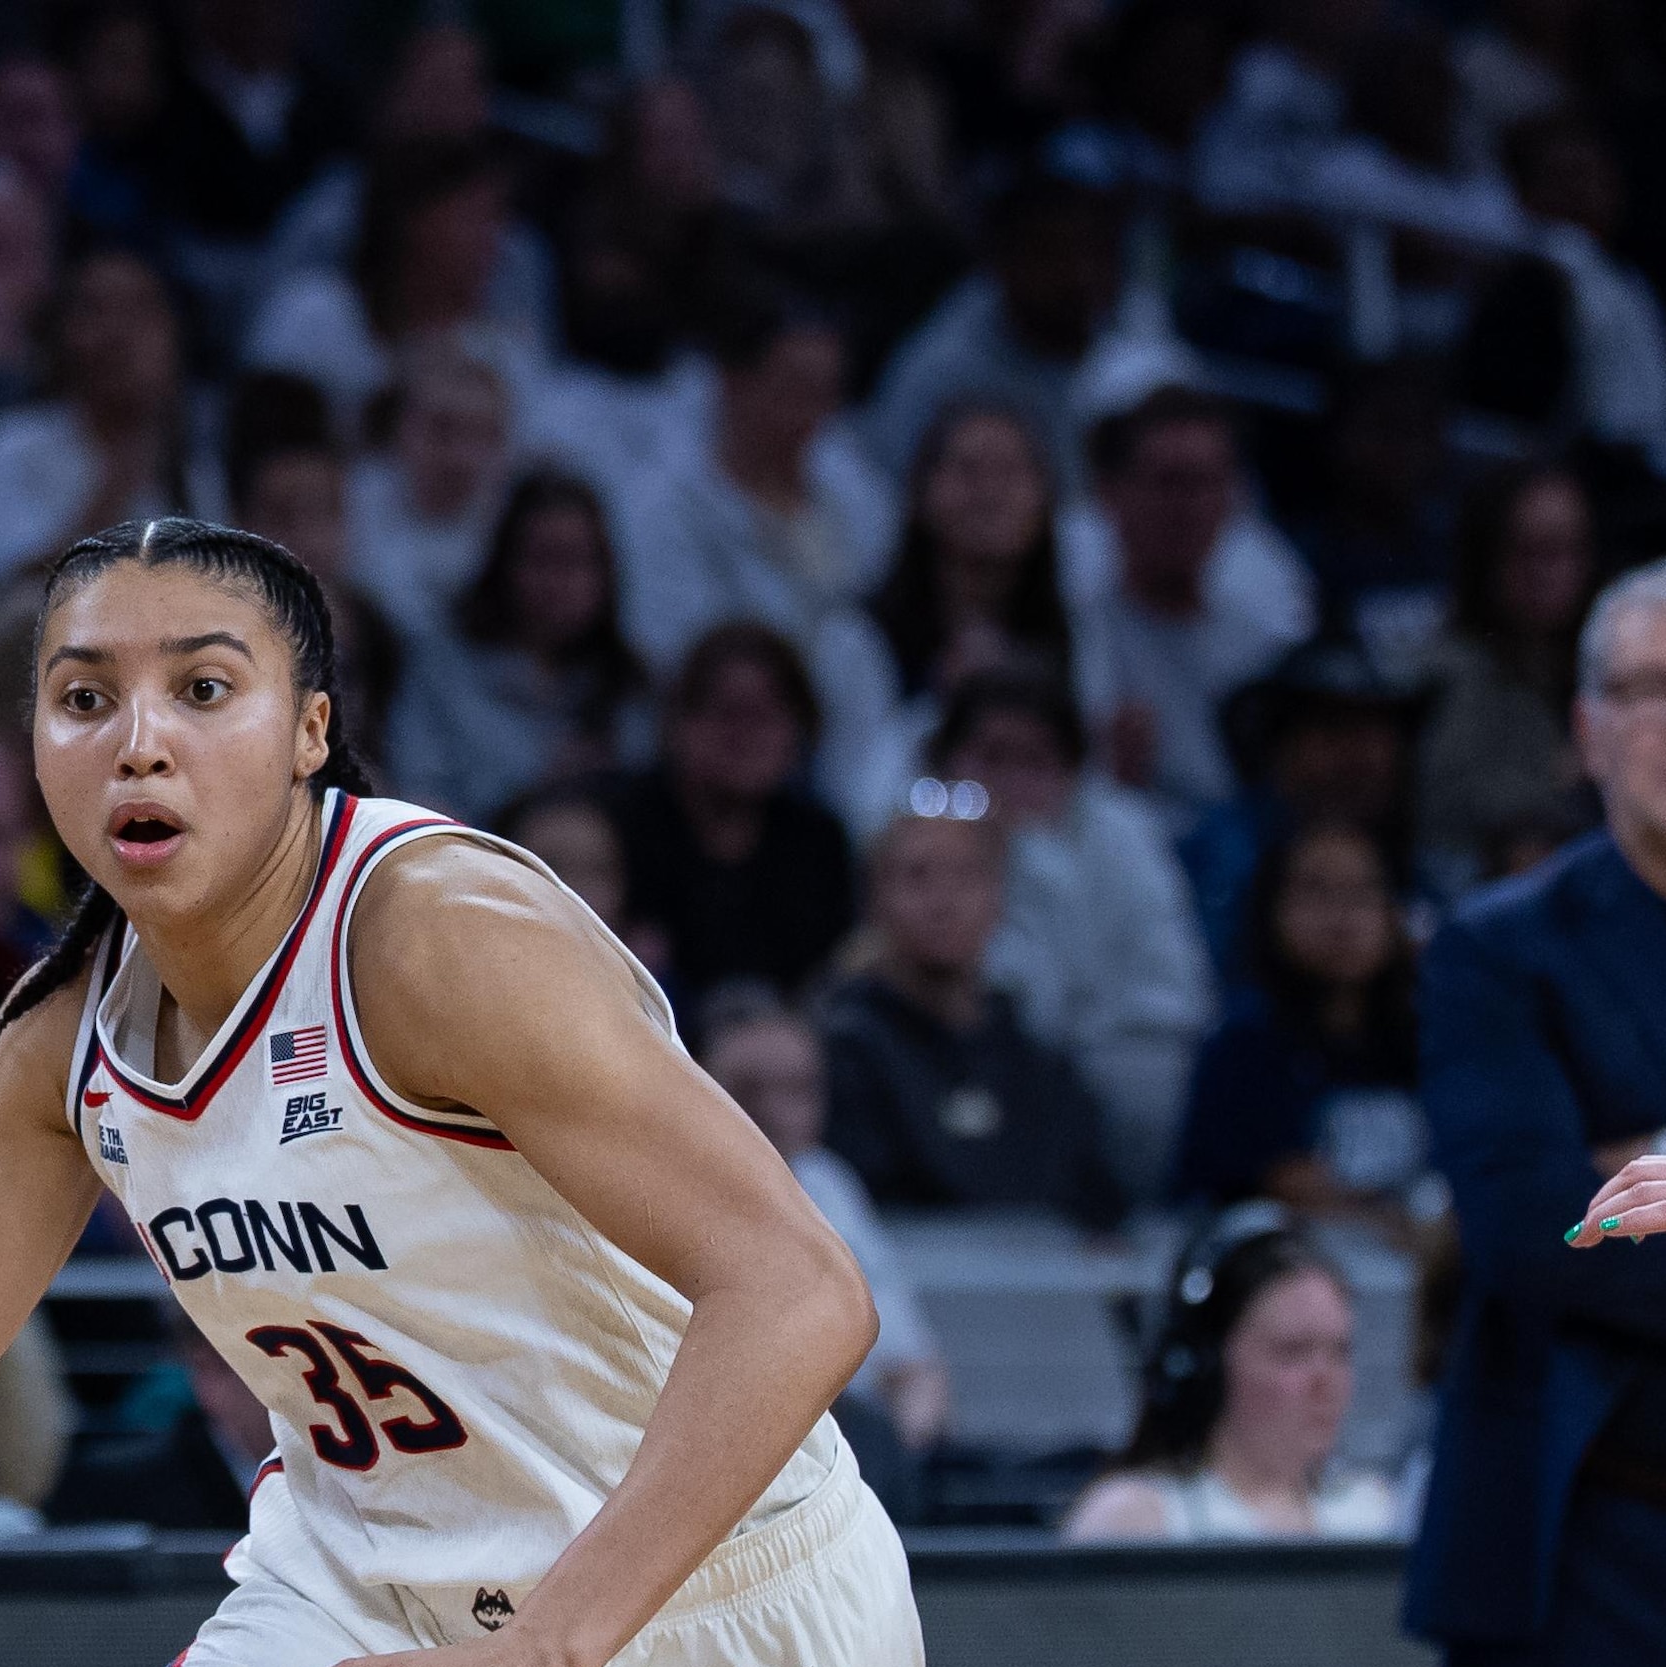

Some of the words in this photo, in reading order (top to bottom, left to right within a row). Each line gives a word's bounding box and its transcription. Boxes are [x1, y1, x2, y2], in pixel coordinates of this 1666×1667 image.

[282, 1108, 344, 1134] EAST
[285, 1092, 327, 1117] BIG
[138, 1198, 389, 1283] CONN
[245, 1319, 469, 1472] 35
